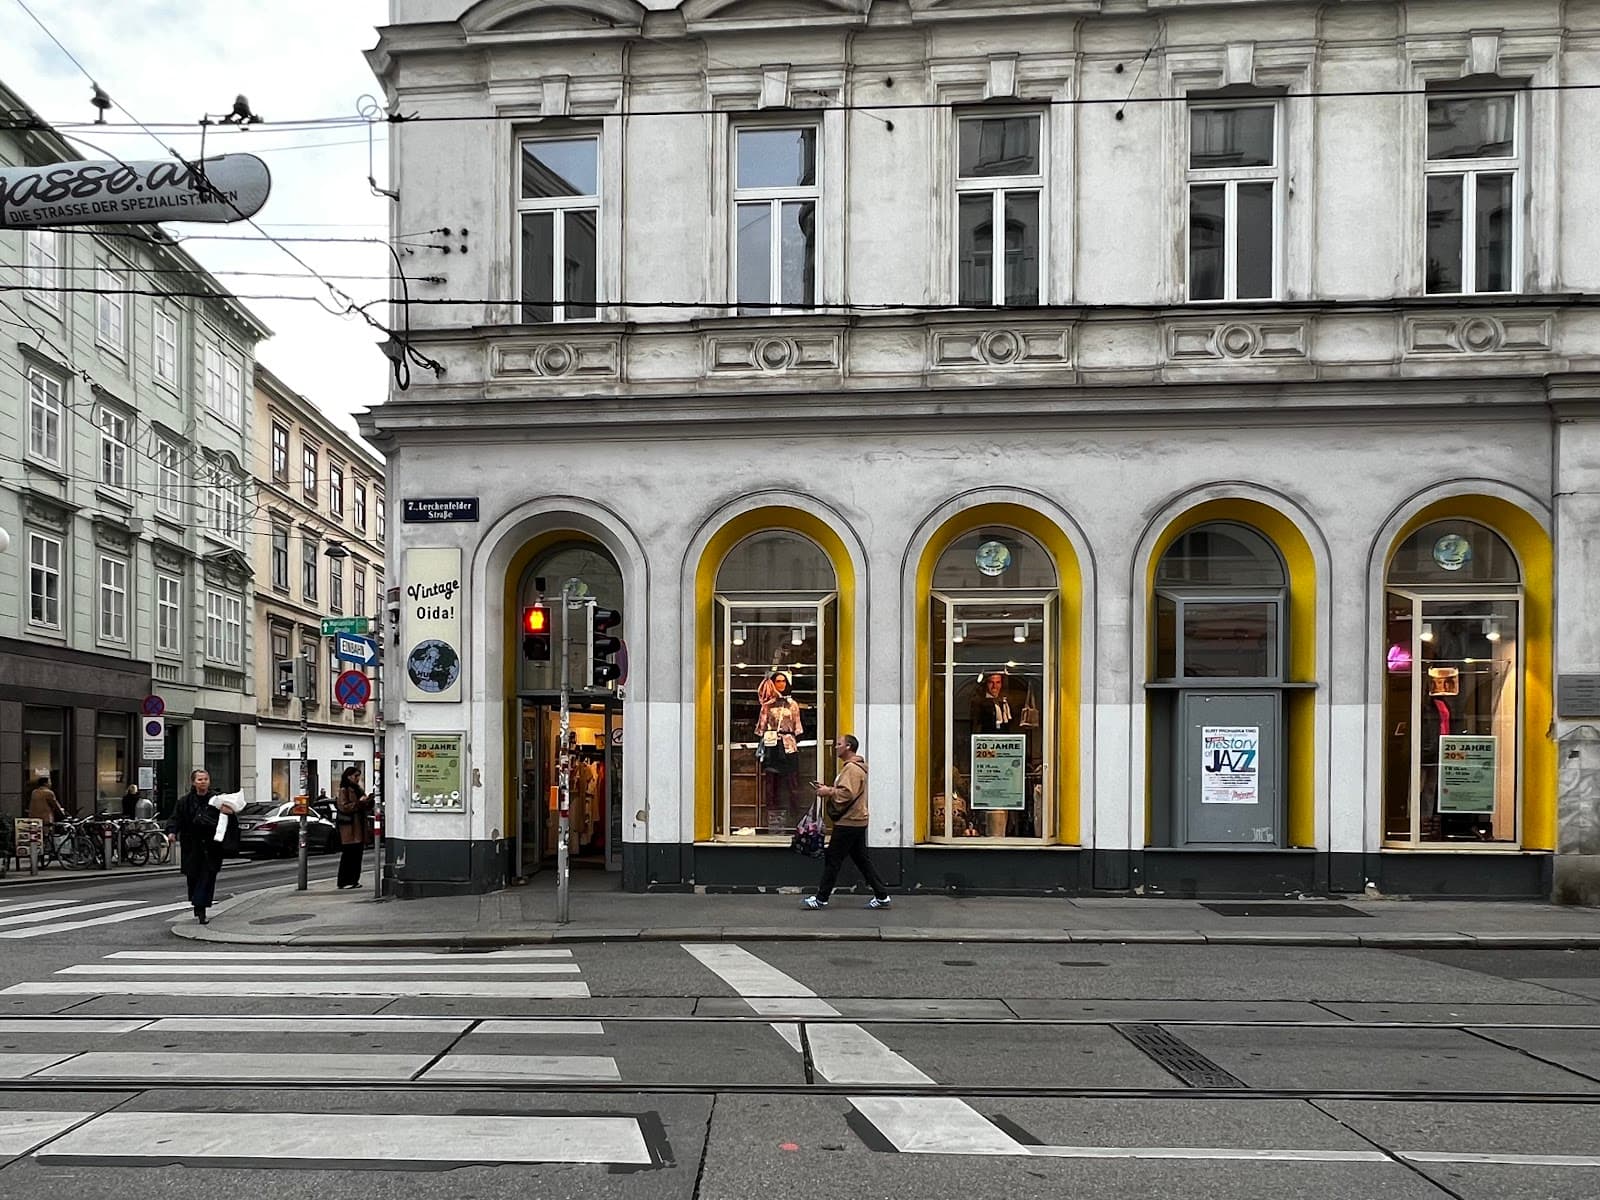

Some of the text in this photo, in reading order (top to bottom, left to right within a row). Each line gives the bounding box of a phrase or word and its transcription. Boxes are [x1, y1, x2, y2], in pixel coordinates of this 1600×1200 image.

[9, 210, 32, 223] DIE
[33, 203, 90, 219] STRASSE
[92, 200, 118, 213] DER
[418, 501, 472, 511] Lerchenfelder
[428, 511, 453, 519] Straße
[407, 579, 460, 600] Vintage
[416, 606, 454, 619] Oida!
[1222, 738, 1256, 749] story
[1205, 750, 1256, 772] JAZZ
